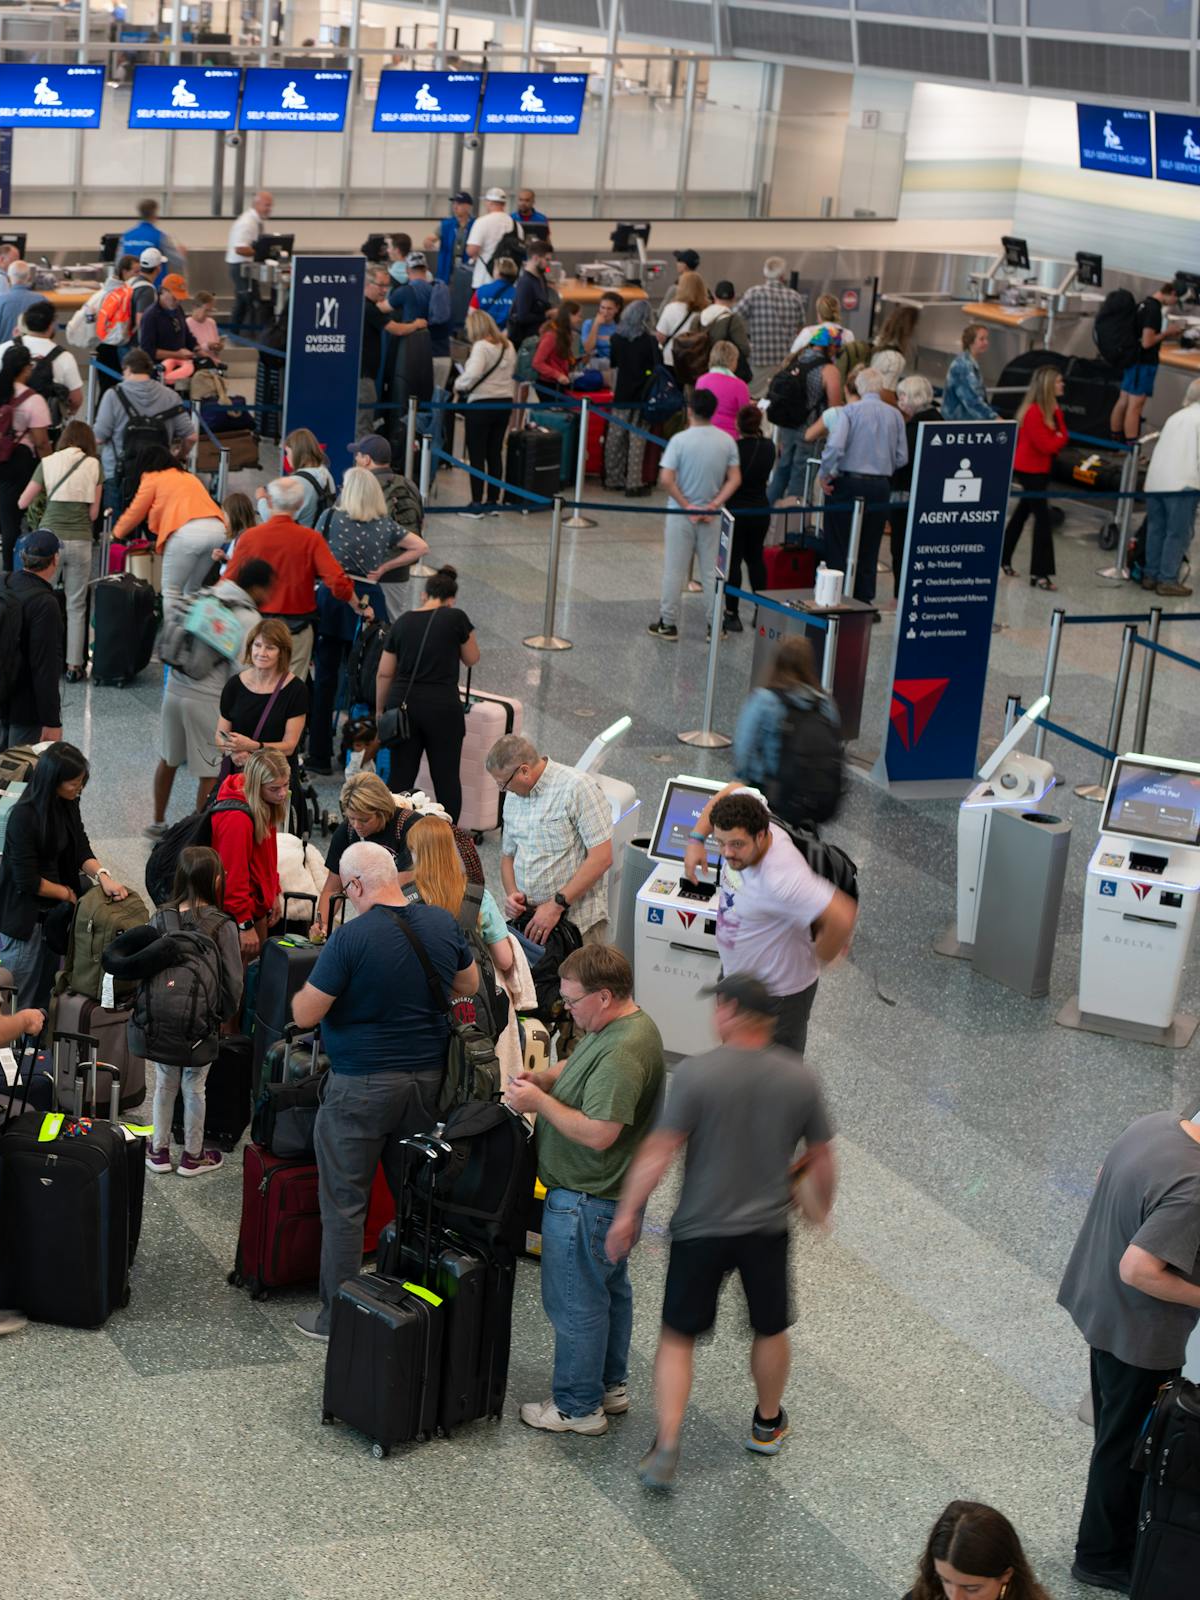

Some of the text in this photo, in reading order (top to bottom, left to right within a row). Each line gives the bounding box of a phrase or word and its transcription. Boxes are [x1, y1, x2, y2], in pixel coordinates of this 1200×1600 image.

[52, 108, 70, 117] BAG
[70, 109, 95, 118] DROP
[136, 110, 231, 120] SELF-SERVICE BAG DROP
[246, 111, 339, 121] SELF-SERVICE BAG DROP
[380, 113, 471, 123] SELF-SERVICE BAG DROP
[486, 115, 575, 124] SELF-SERVICE BAG DROP
[313, 275, 347, 284] DELTA
[306, 334, 346, 344] OVERSIZE
[305, 344, 346, 353] BAGGAGE
[946, 433, 993, 444] DELTA
[919, 510, 1000, 524] AGENT ASSIST
[916, 544, 985, 554] SERVICES OFFERED:
[927, 561, 962, 569] Re-Ticketing
[926, 578, 950, 586] Checked
[924, 594, 988, 603] Unaccompanied Minors
[922, 612, 946, 620] Carry-on
[920, 630, 936, 638] Agent
[1115, 936, 1152, 950] DELTA
[664, 966, 700, 980] DELTA
